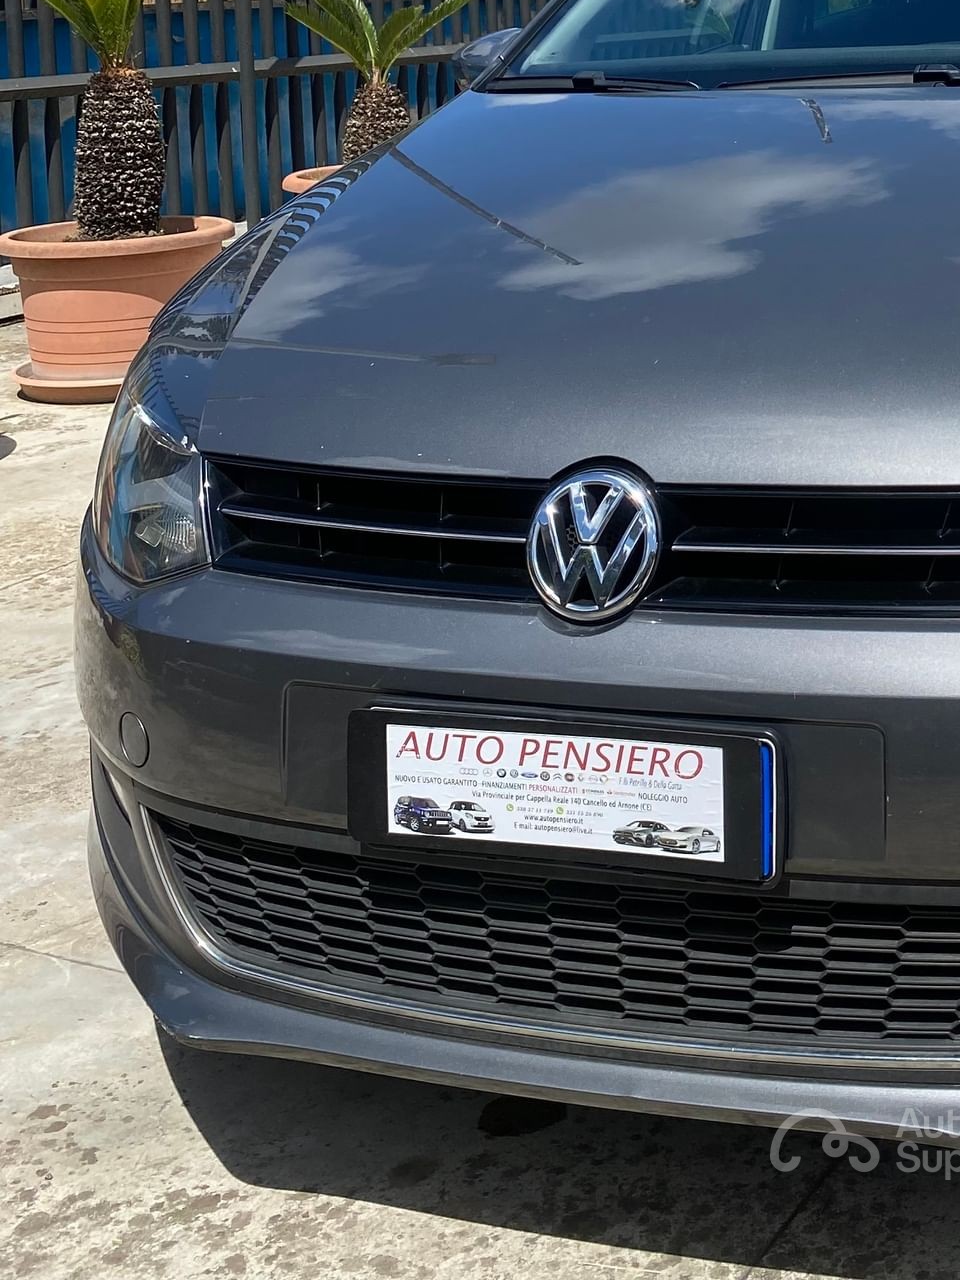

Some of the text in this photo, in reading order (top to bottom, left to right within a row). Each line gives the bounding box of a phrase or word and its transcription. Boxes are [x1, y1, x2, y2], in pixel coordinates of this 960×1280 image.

[395, 730, 704, 780] AUTO PENSIERO
[394, 775, 416, 783] NUOVO
[422, 777, 442, 785] USATO
[443, 778, 478, 787] GARANTITO
[481, 781, 527, 791] FINANZIAMENTI
[528, 784, 578, 794] PERSONALIZZATI
[638, 792, 669, 803] NOLEGGIO
[671, 795, 688, 804] AUTO
[472, 790, 482, 798] Via
[483, 791, 513, 801] Provinciale
[515, 793, 525, 802] per
[526, 794, 552, 804] Cappella
[553, 797, 569, 805] Reale
[582, 798, 607, 808] Cancello
[608, 800, 616, 808] ed
[618, 801, 639, 810] Arnone
[640, 802, 652, 812] (CE)
[524, 814, 584, 825] www.autopensiero.it
